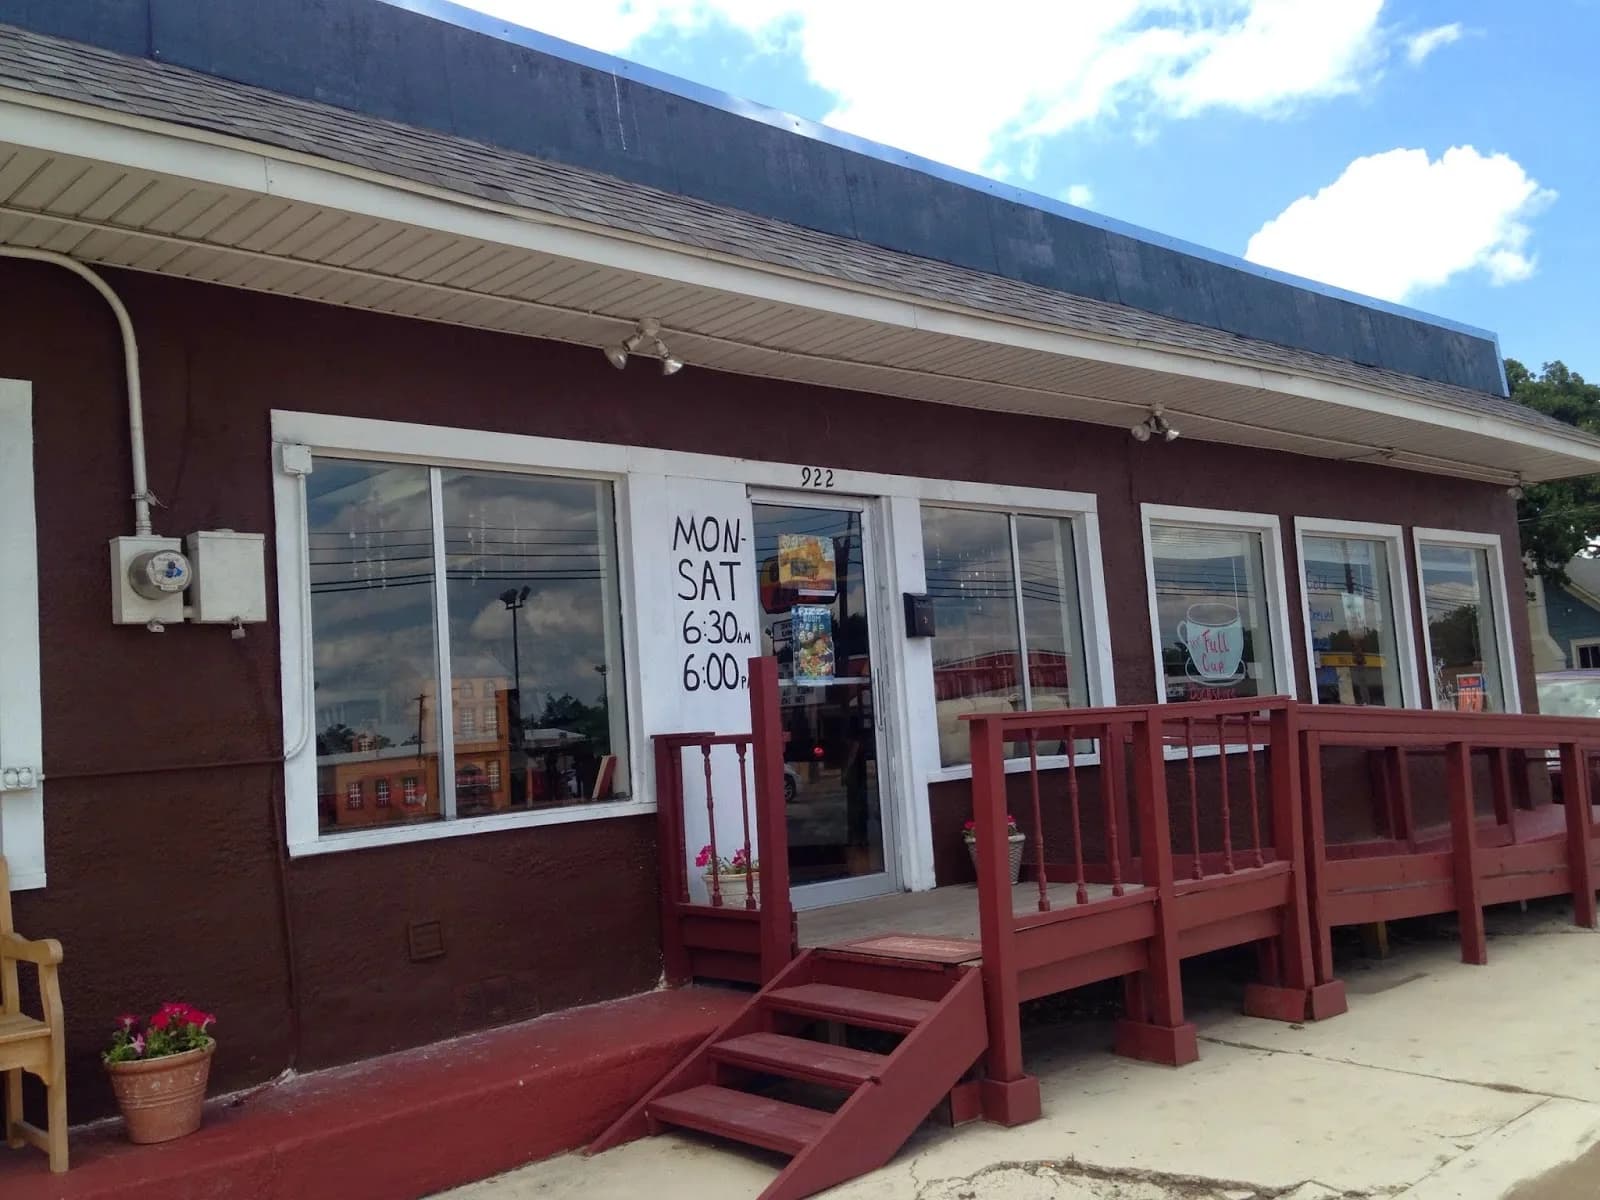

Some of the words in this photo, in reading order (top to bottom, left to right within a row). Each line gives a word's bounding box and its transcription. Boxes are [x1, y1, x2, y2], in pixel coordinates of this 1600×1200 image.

[801, 467, 834, 488] 922
[673, 516, 747, 553] MON-
[677, 559, 741, 601] SAT
[1201, 629, 1230, 653] Full
[1202, 652, 1225, 673] Cup
